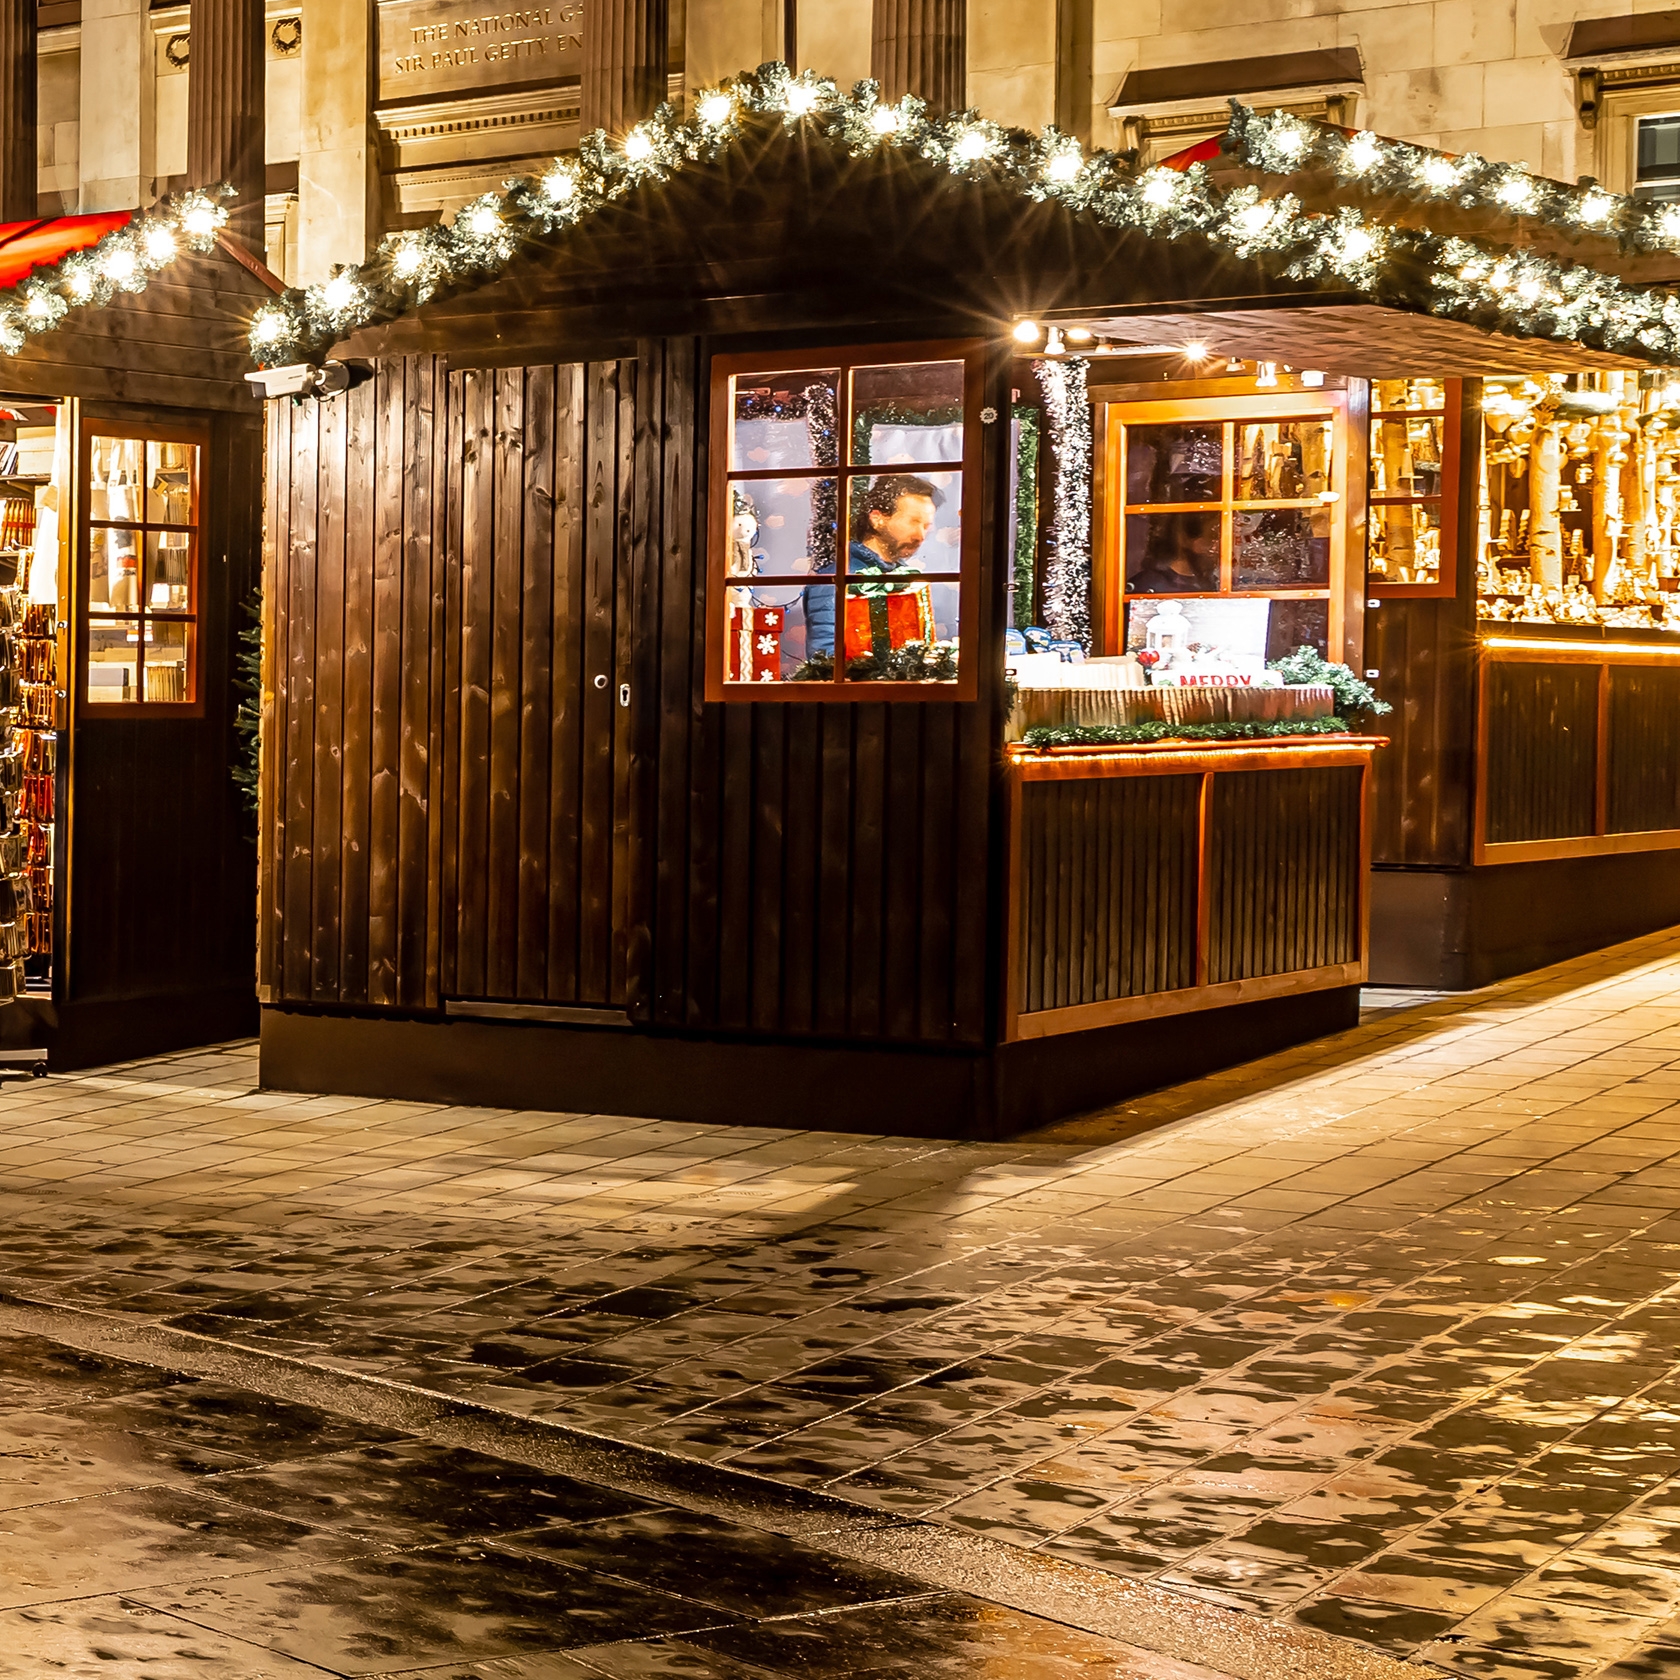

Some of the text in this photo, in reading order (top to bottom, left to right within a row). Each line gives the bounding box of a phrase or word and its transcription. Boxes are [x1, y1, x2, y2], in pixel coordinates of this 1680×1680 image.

[410, 23, 448, 44] THE
[454, 8, 553, 38] NATIONAL
[395, 55, 425, 74] SIR
[431, 47, 479, 68] PAUL
[484, 37, 549, 62] GETTY
